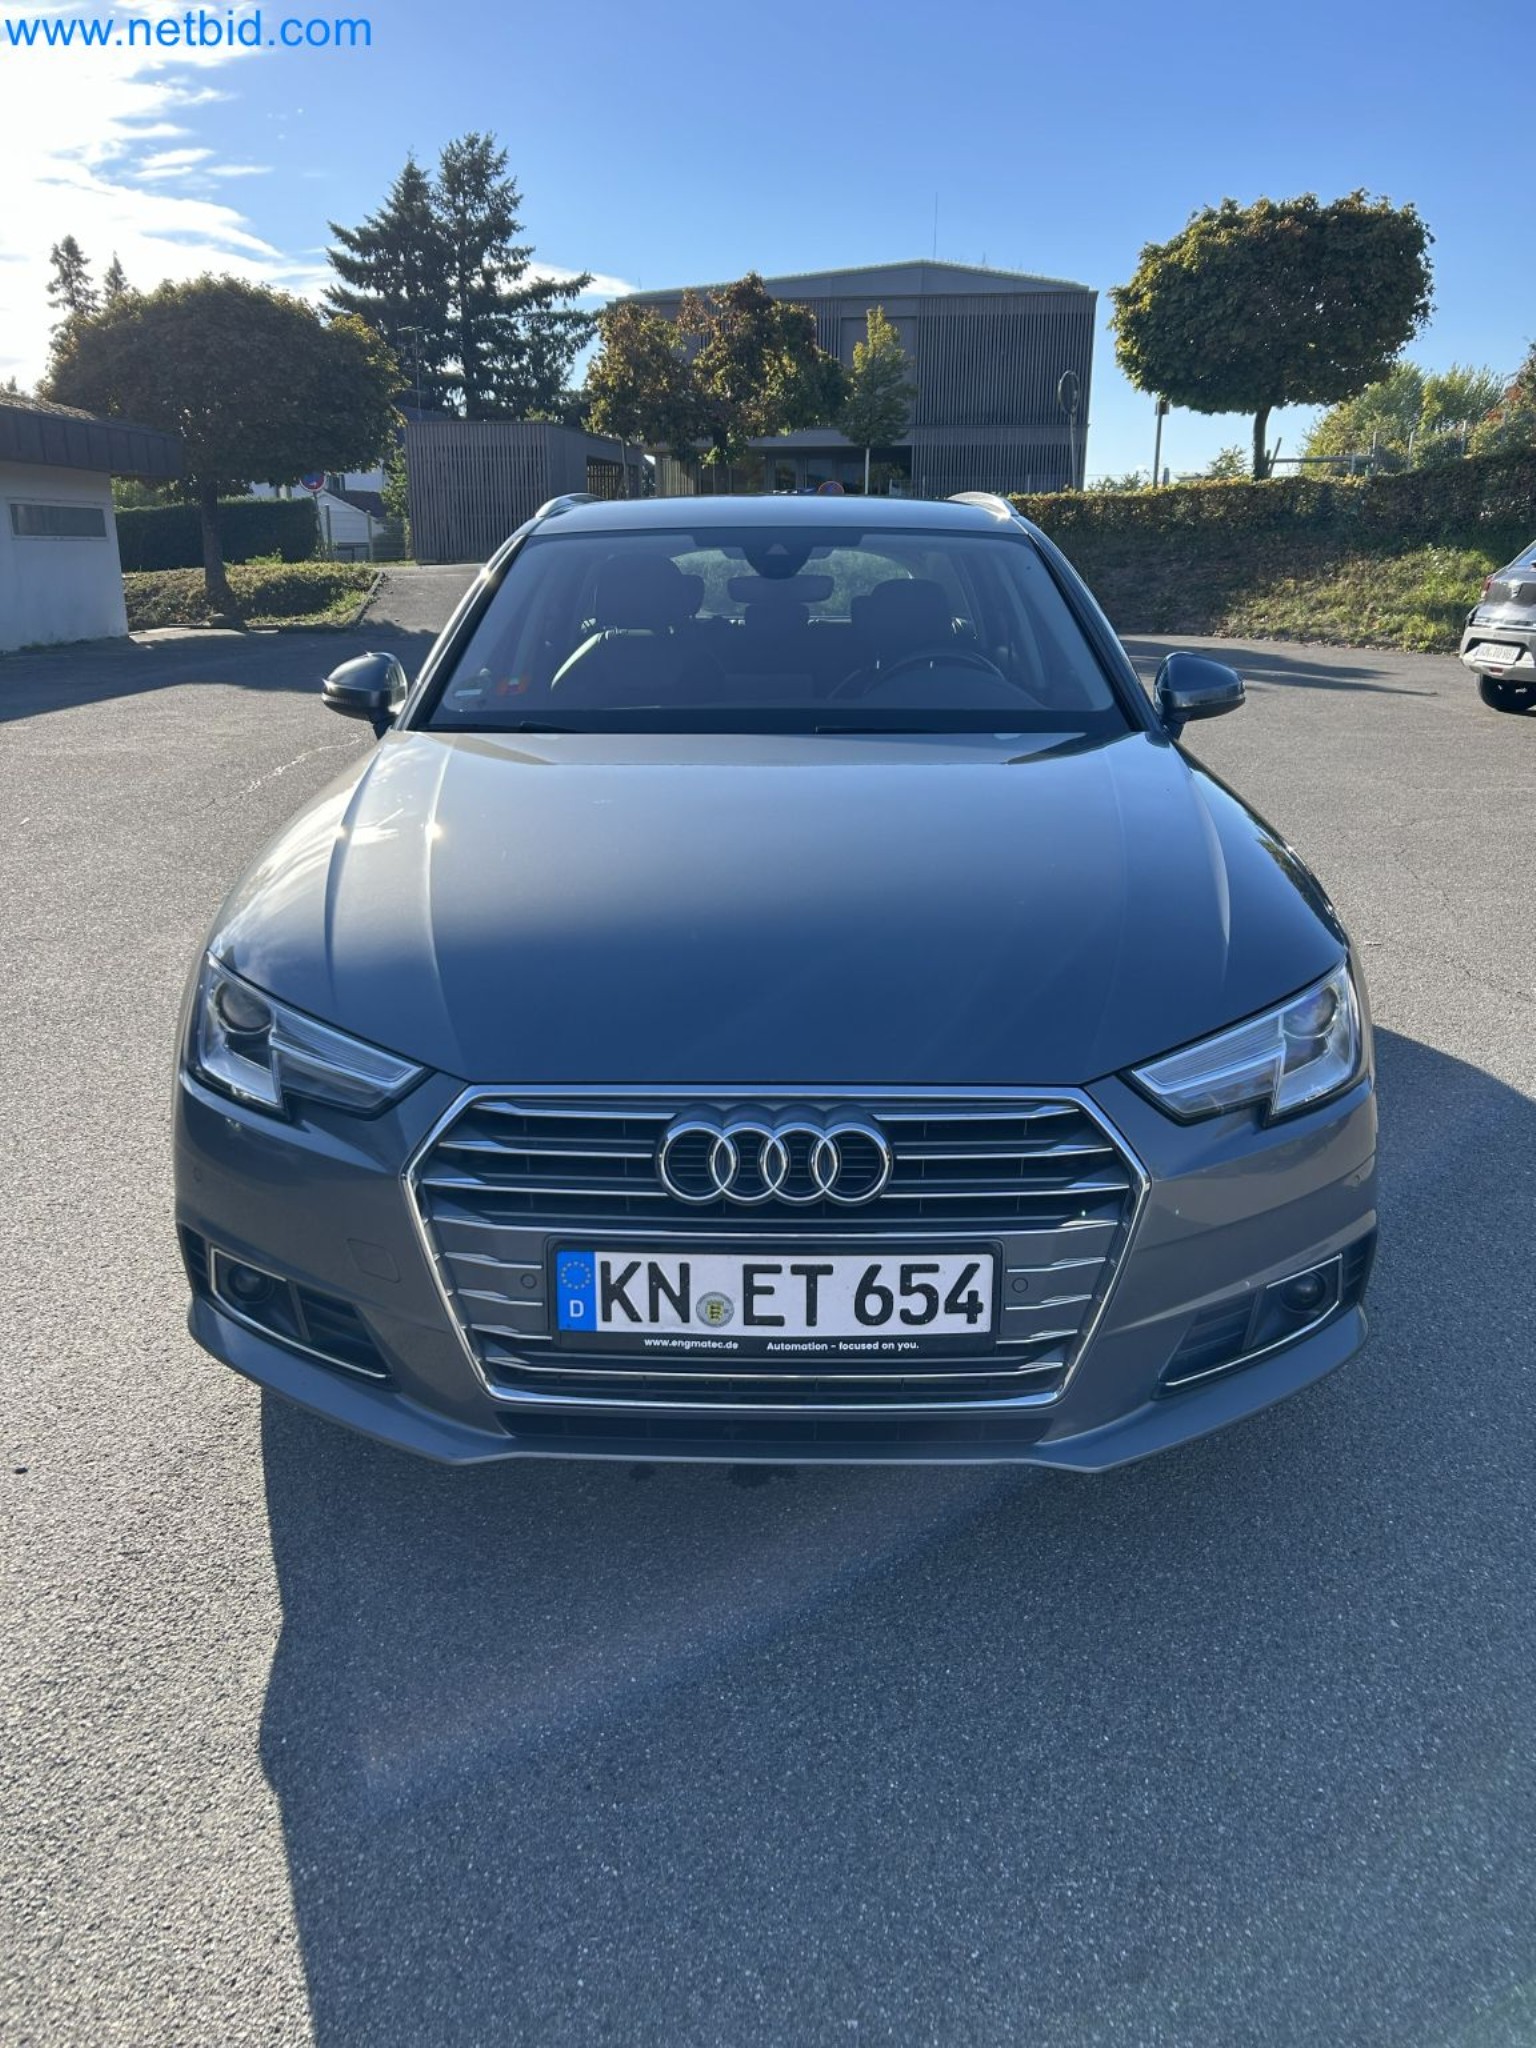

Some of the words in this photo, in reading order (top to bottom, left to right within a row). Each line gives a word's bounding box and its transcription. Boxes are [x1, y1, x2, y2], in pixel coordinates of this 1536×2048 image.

[601, 1260, 690, 1323] KN
[743, 1263, 834, 1327] ET
[853, 1263, 984, 1326] 654
[569, 1300, 584, 1317] D
[644, 1339, 739, 1349] www.engmatec.de
[766, 1342, 828, 1350] Automation
[839, 1341, 879, 1350] focused
[897, 1341, 920, 1351] you.
